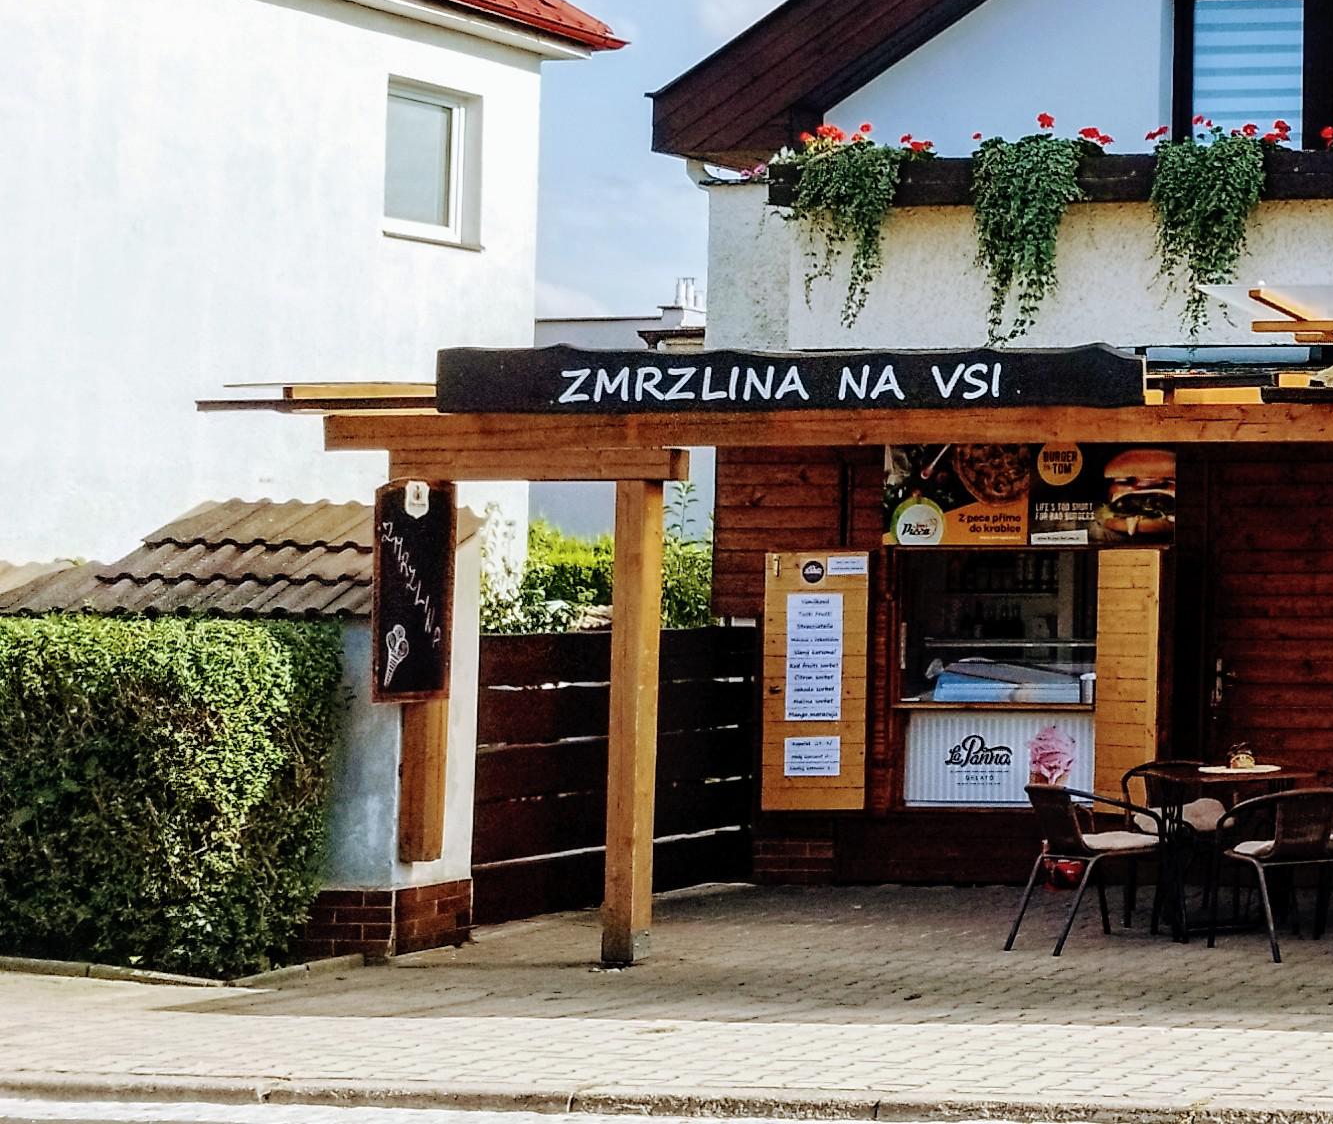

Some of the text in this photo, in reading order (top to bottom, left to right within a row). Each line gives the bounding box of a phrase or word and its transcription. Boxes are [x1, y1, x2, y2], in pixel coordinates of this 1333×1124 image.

[558, 363, 1002, 404] ZMRZLINA NA VSI
[1043, 451, 1078, 462] BURGER
[1053, 463, 1072, 474] TOM
[969, 524, 1021, 533] do krabice
[381, 521, 442, 649] ZMRZLINA
[945, 734, 1013, 768] La Panna
